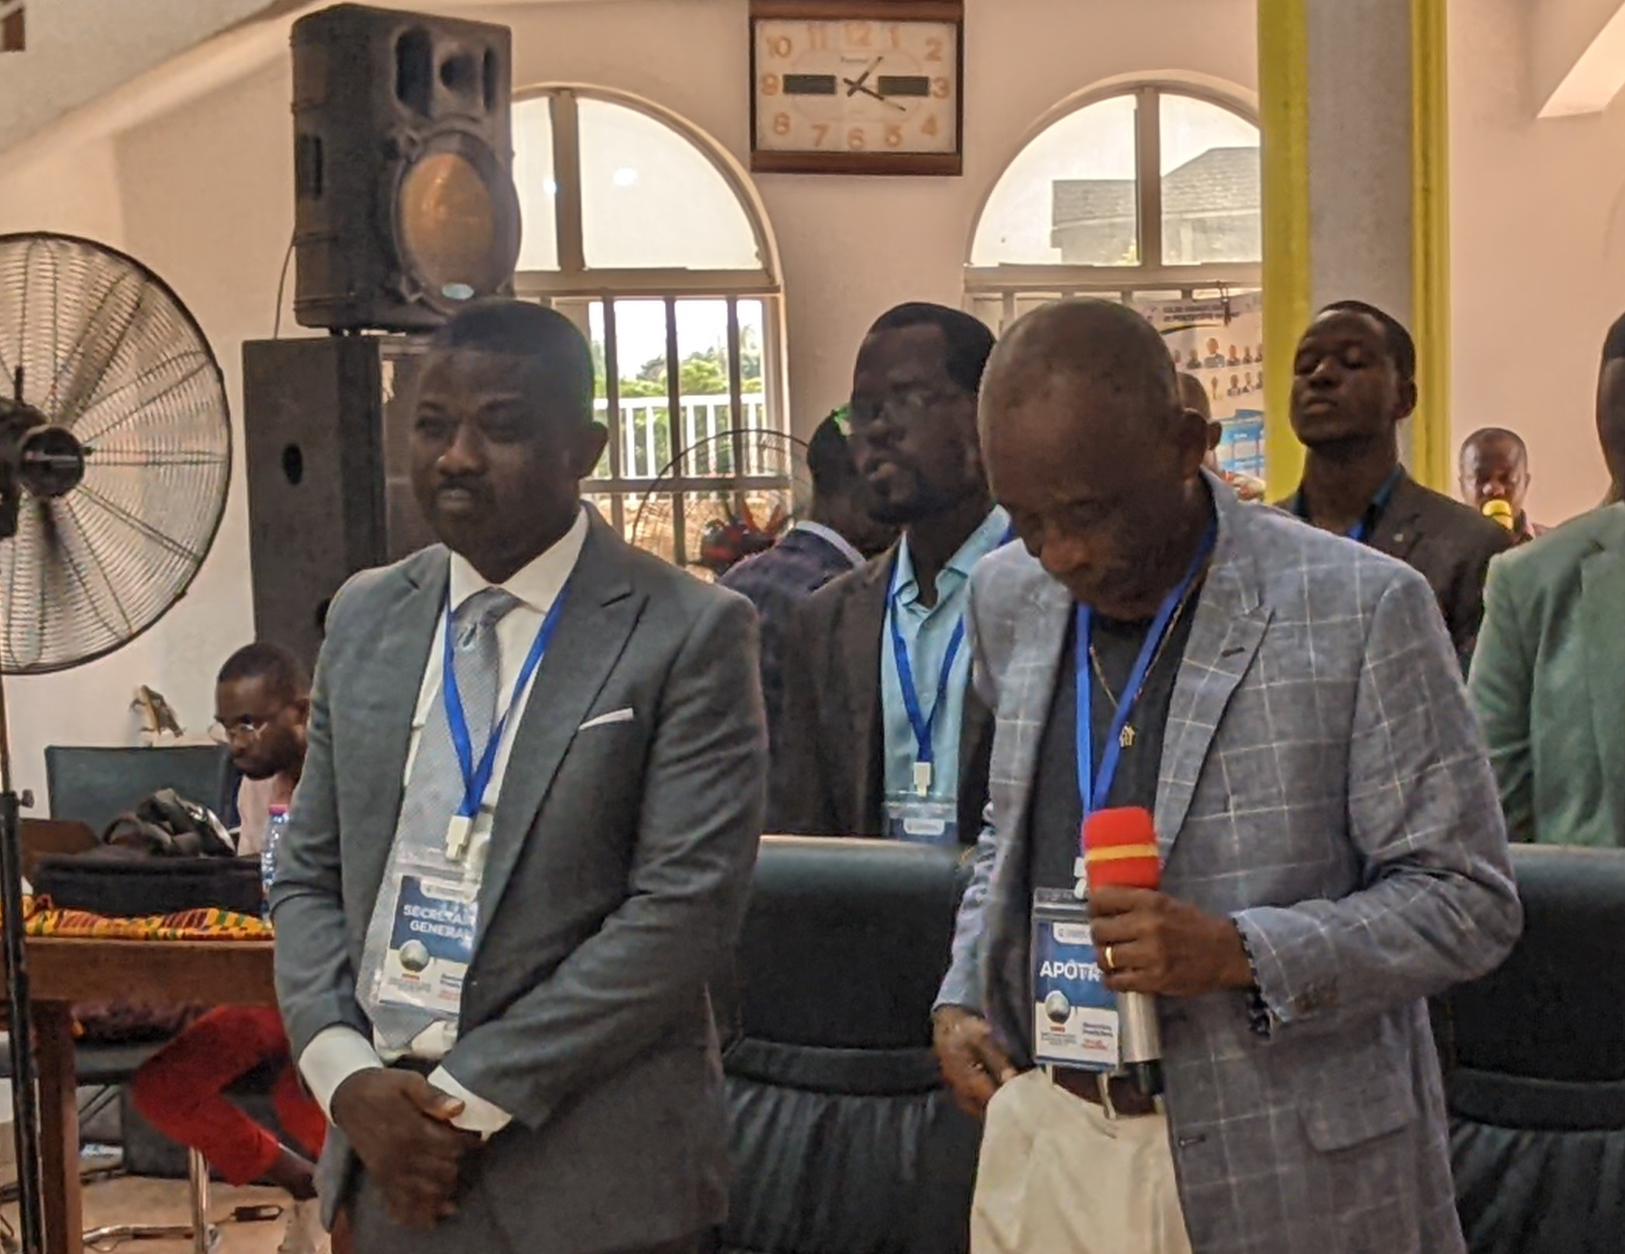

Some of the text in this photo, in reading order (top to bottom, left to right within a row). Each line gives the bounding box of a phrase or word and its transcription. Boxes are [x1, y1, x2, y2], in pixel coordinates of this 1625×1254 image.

[766, 36, 792, 58] 10
[925, 36, 943, 61] 2
[761, 73, 779, 96] 9
[932, 76, 950, 99] 3
[811, 123, 829, 147] 7
[920, 114, 938, 136] 4
[847, 127, 865, 149] 6
